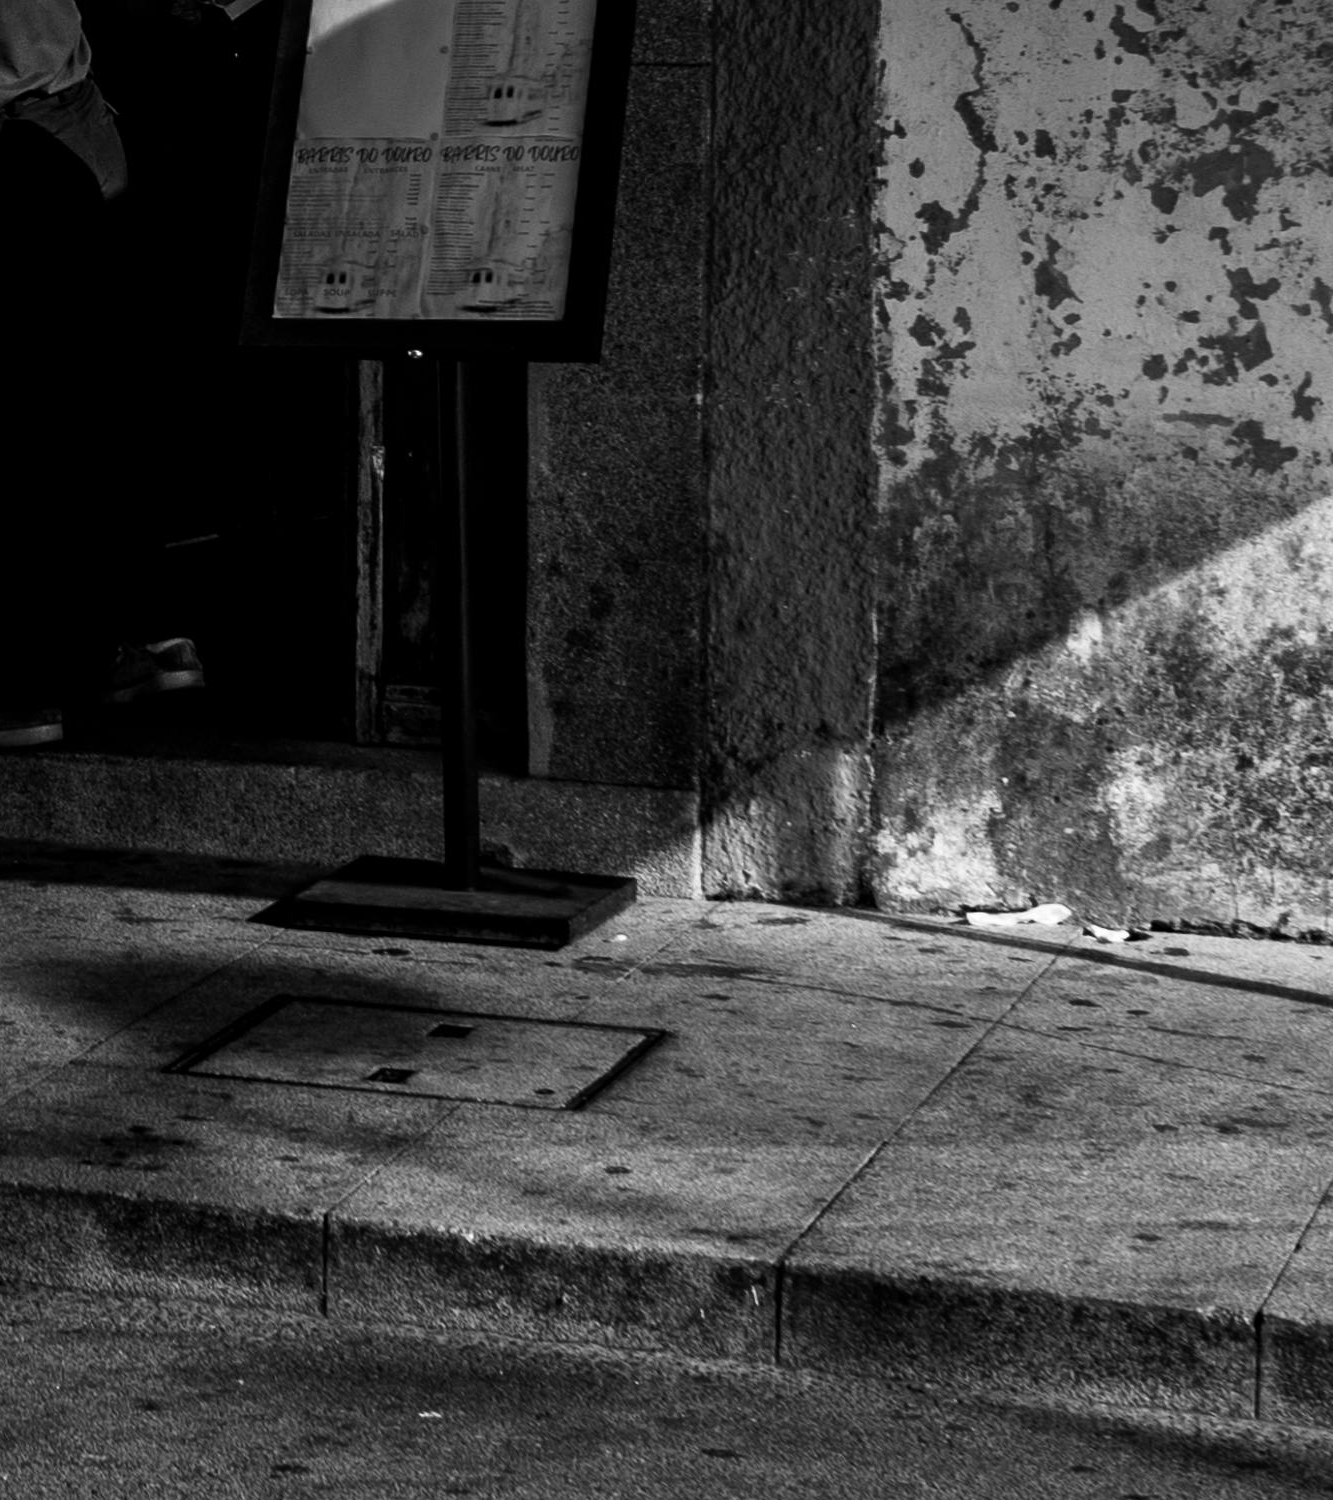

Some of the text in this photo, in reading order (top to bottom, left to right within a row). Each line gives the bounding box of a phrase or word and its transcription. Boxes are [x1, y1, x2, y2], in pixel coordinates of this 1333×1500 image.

[296, 146, 433, 164] BARRIS DO DOURO
[440, 145, 581, 164] BARRIS DO DOURO
